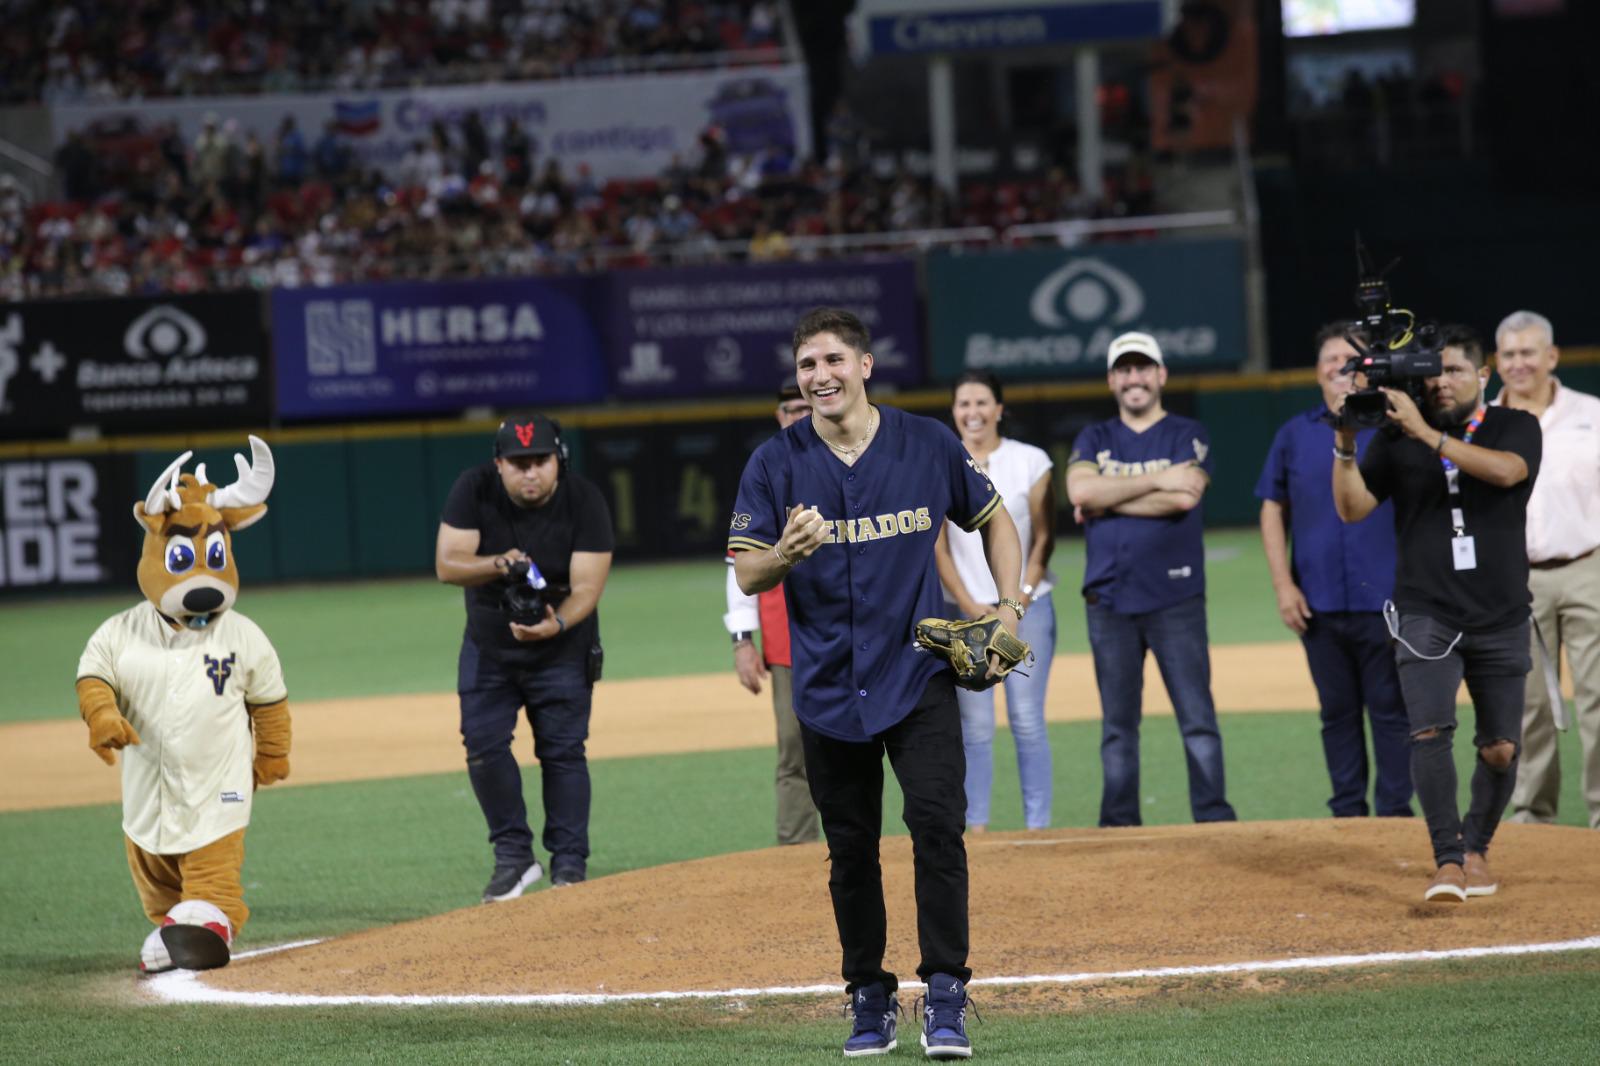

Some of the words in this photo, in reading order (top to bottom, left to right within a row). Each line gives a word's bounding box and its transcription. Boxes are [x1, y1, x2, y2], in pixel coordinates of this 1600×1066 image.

[894, 14, 1047, 49] Chevron
[381, 302, 543, 346] HERSA
[965, 333, 1083, 367] Banco
[76, 359, 162, 388] Banco
[165, 355, 258, 383] Azteca
[0, 458, 98, 525] ER
[786, 506, 932, 544] ENADOS
[0, 522, 101, 586] DE
